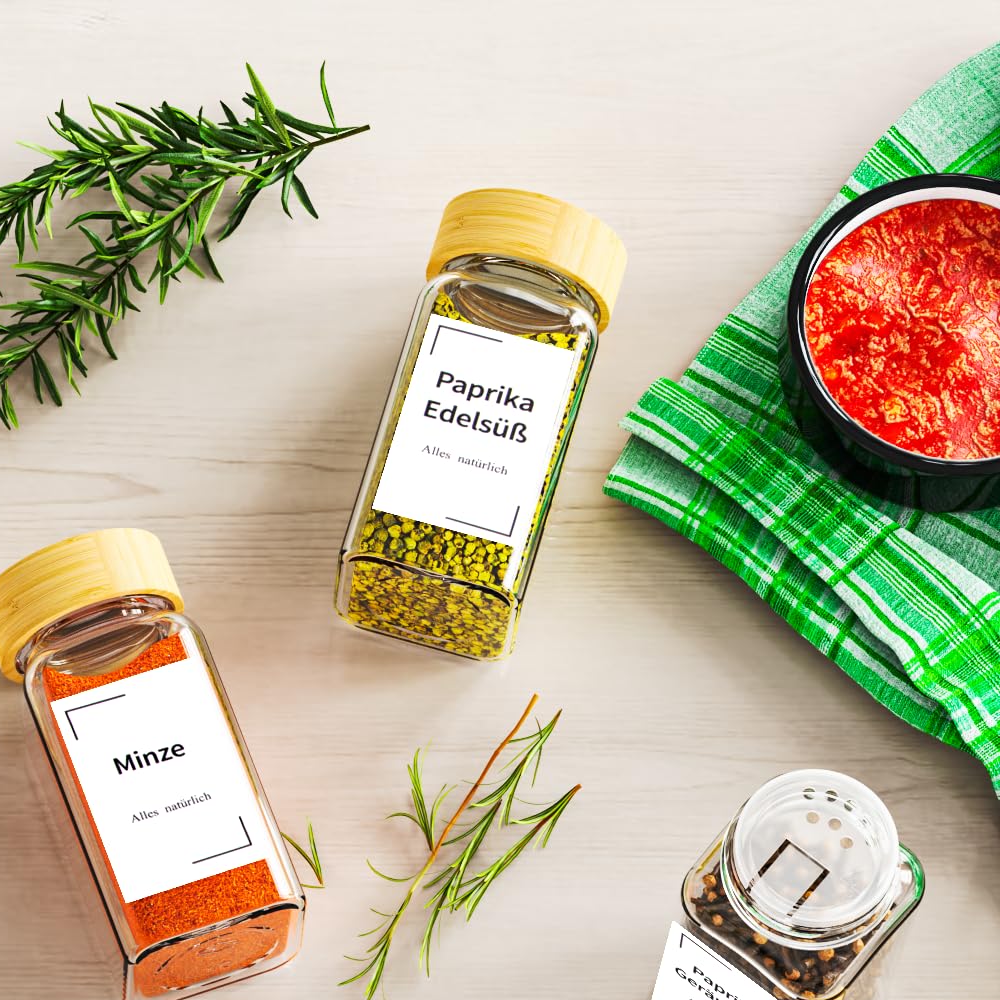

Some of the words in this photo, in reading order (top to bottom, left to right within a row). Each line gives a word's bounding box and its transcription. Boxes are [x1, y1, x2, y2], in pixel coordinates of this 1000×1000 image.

[435, 370, 535, 413] Paprika
[423, 399, 528, 444] Edelsüß
[421, 444, 451, 460] Alles
[457, 454, 508, 476] natürlich
[113, 743, 186, 775] Minze
[131, 808, 159, 824] Alles
[164, 791, 212, 813] natürlich
